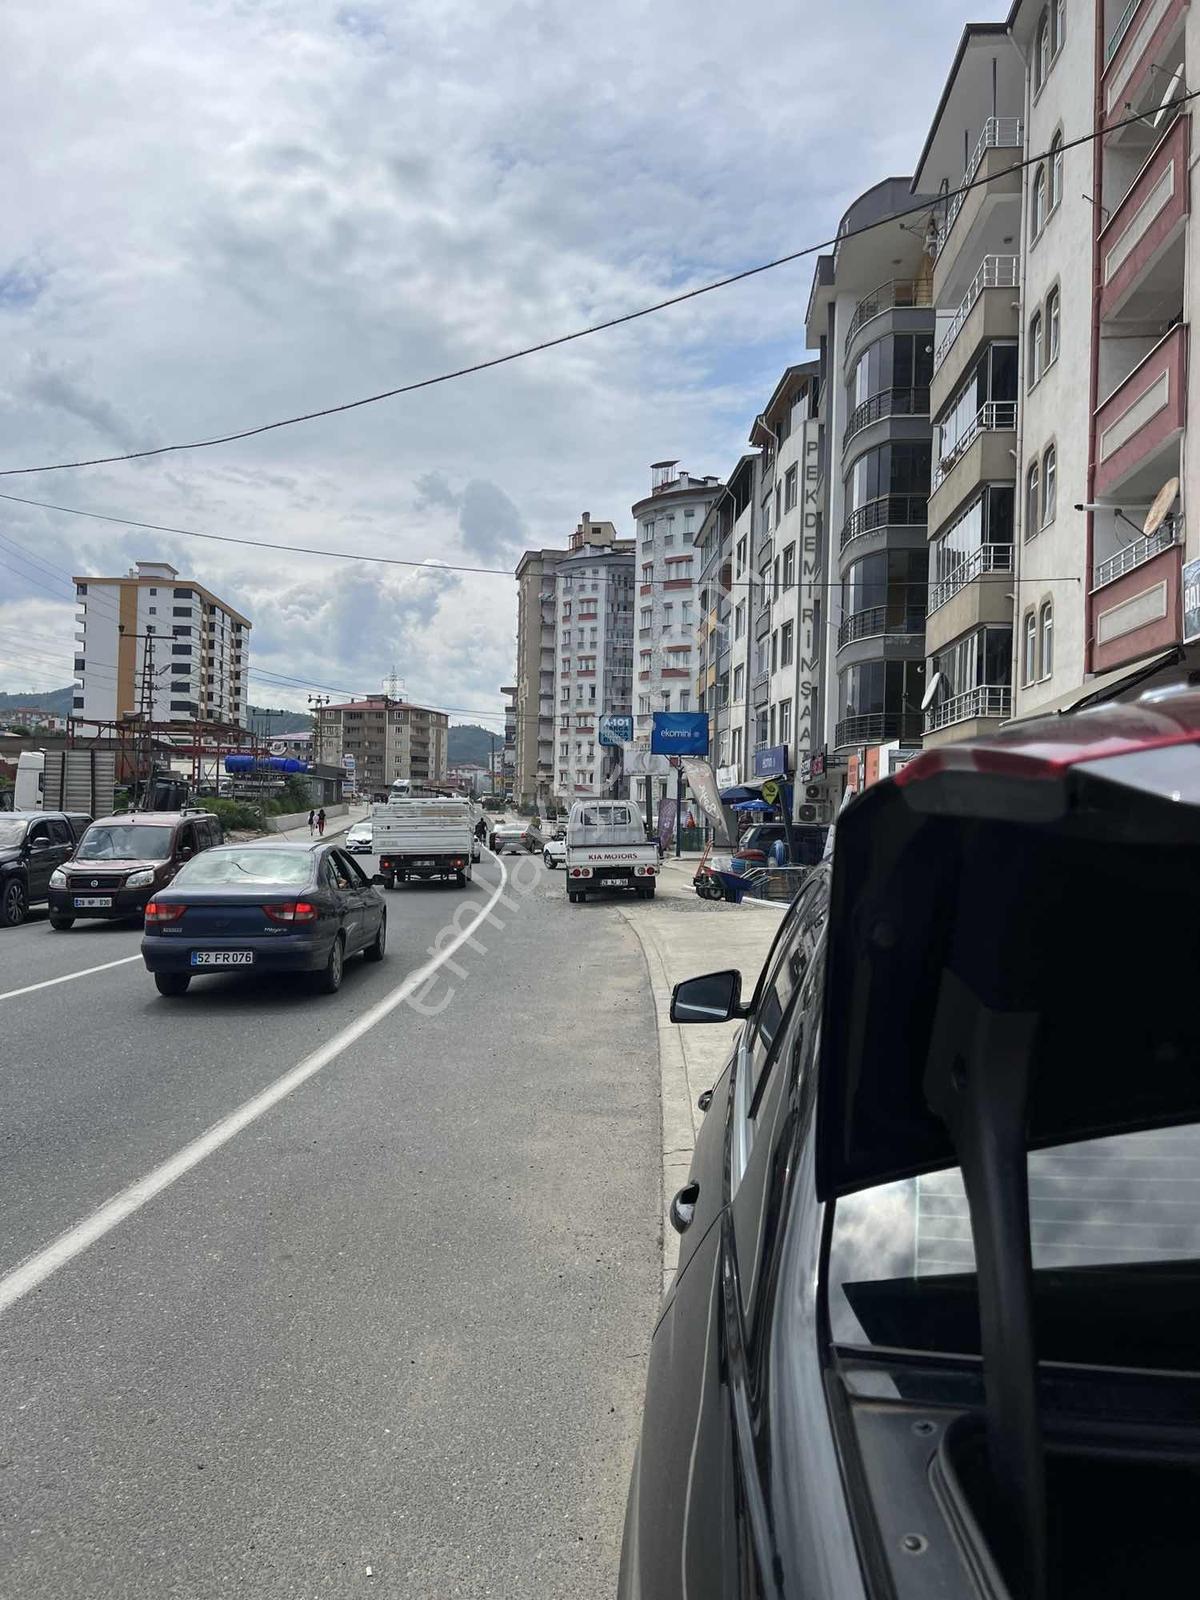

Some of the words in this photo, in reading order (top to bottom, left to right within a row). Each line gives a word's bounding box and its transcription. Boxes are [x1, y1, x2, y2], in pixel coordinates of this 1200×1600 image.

[803, 441, 818, 624] PEKDEMİR
[660, 727, 691, 738] ekomini
[197, 953, 210, 963] 52
[214, 953, 230, 963] FR
[231, 953, 252, 963] 076
